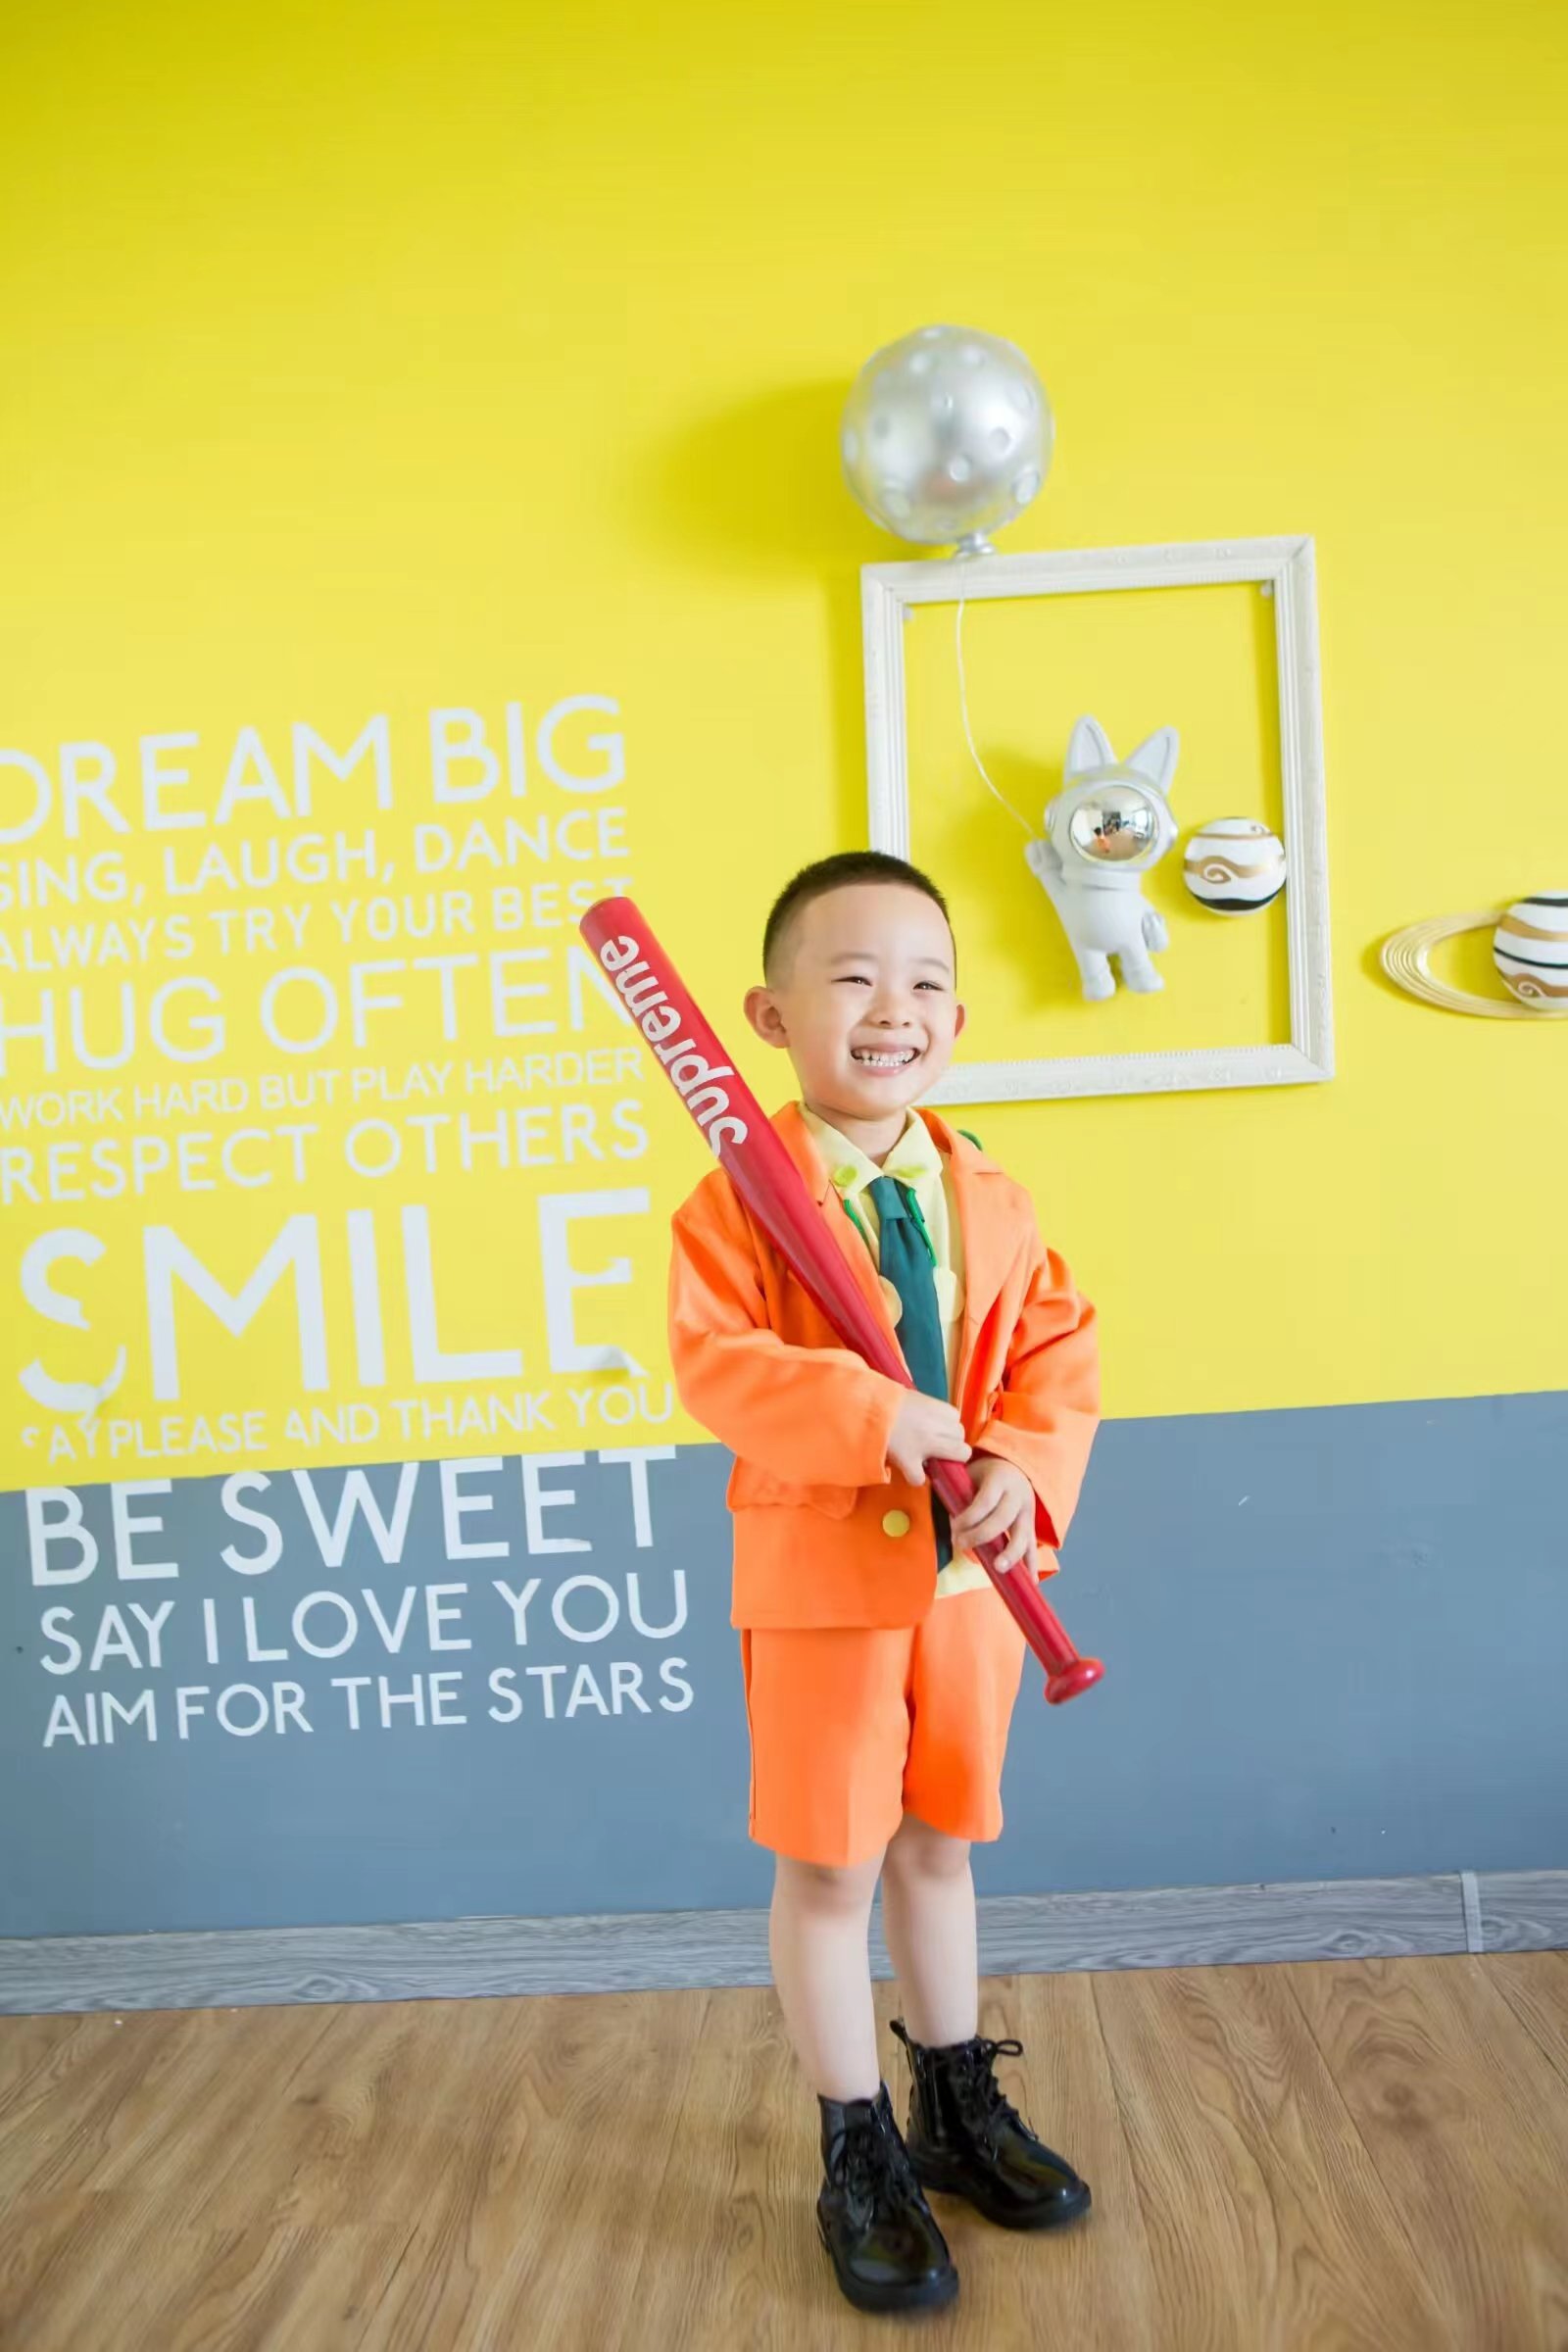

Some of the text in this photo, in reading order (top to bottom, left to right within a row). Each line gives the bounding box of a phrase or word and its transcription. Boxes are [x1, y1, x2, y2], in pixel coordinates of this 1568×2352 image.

[428, 694, 626, 805] BIG
[163, 828, 396, 897] LAUGH,
[414, 807, 630, 874] DANCE
[208, 899, 312, 956] TRY
[329, 886, 476, 944] YOUR
[0, 975, 226, 1079] HUG
[600, 935, 749, 1158] Supreme
[0, 1046, 647, 1130] WORK HARD BUT PLAY HARDER
[0, 1097, 650, 1205] RESPECT OTHERS
[20, 1186, 651, 1411] SMILE
[108, 1409, 270, 1459] PLEASE
[283, 1402, 380, 1450] AND
[389, 1388, 554, 1441] THANK
[566, 1383, 676, 1429] YOU
[25, 1444, 676, 1586] BE SWEET
[40, 1570, 688, 1675] SAY I LOVE YOU
[43, 1656, 694, 1747] AIM FOR THE STARS
